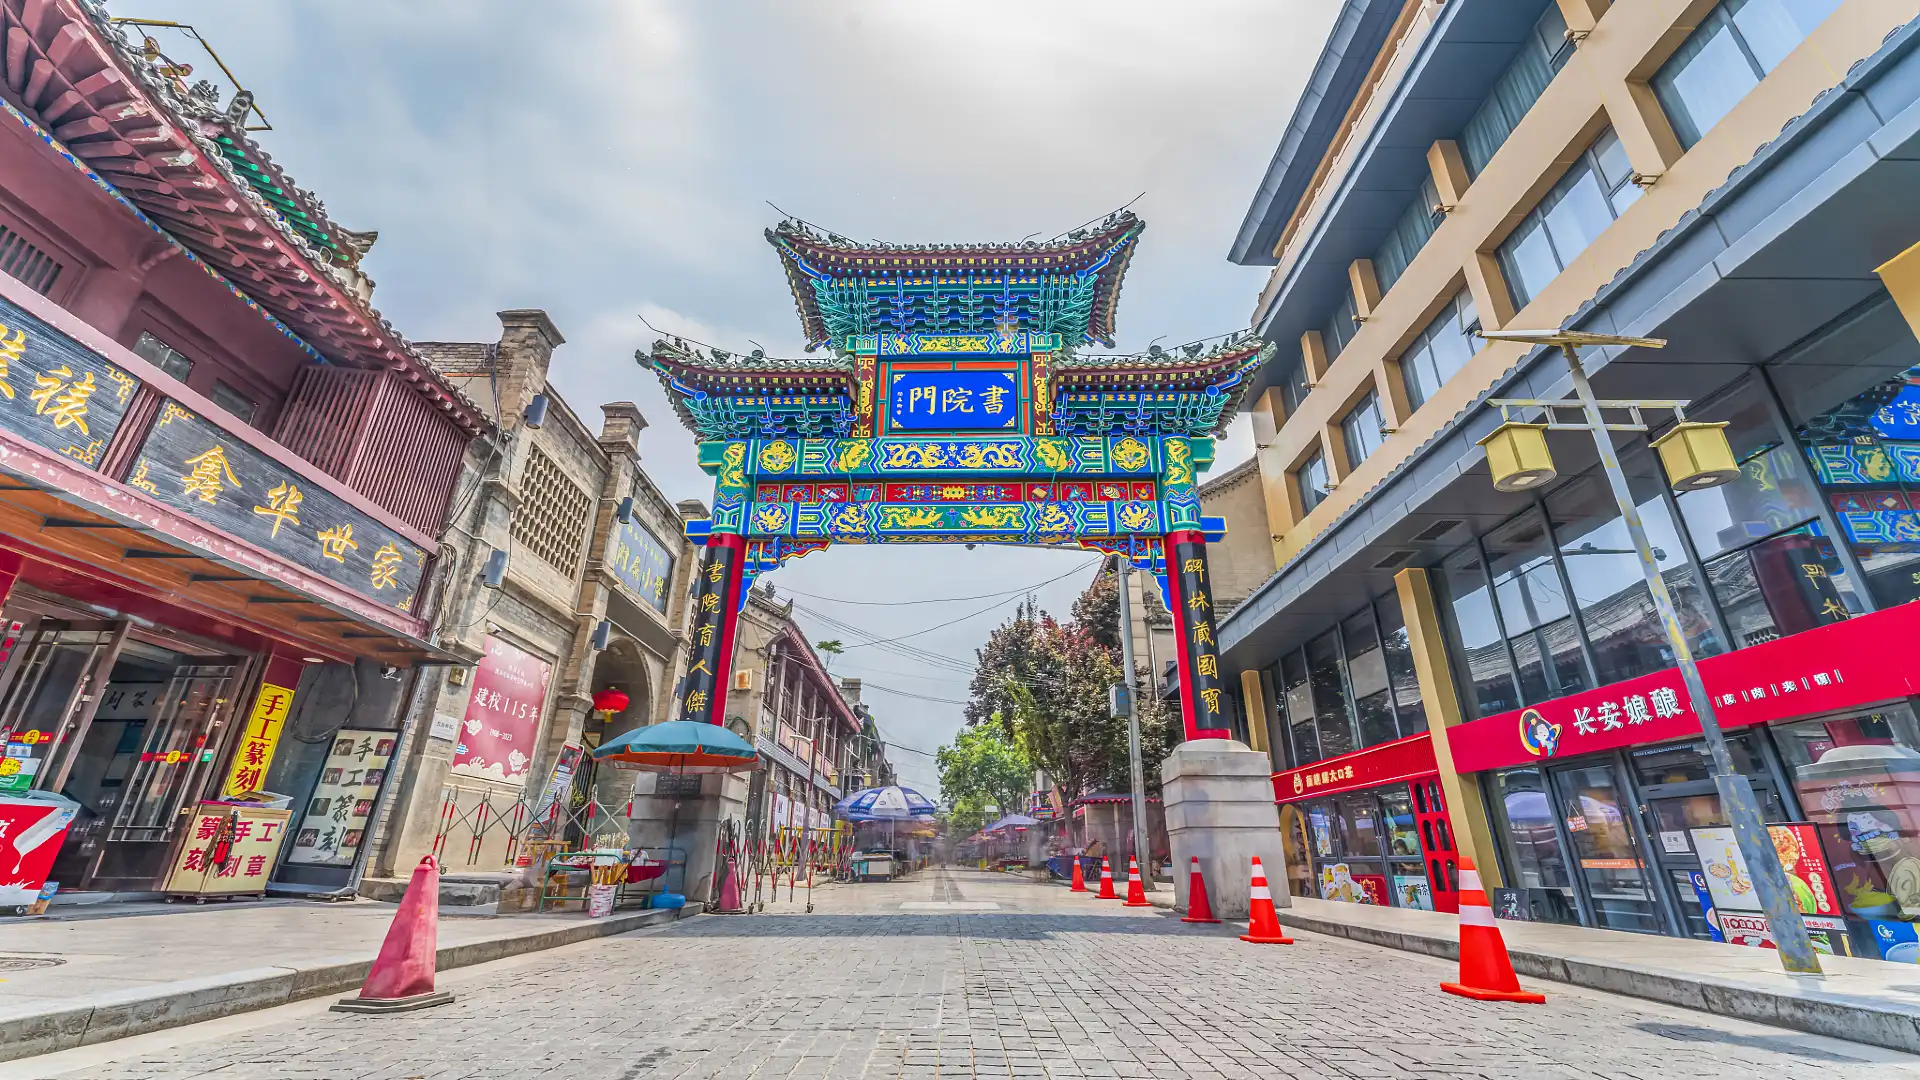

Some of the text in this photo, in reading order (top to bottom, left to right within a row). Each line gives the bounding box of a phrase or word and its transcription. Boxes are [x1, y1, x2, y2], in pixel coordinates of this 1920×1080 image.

[909, 384, 1009, 415] 書院門
[181, 444, 403, 589] 鑫华世家
[685, 559, 725, 713] 書院育人傑
[1183, 558, 1222, 714] 碑林藏國寶
[234, 694, 284, 792] 手工篆刻
[474, 687, 538, 724] 建校115年
[1573, 686, 1684, 736] 长安娘酿
[317, 735, 374, 855] 手工篆刻
